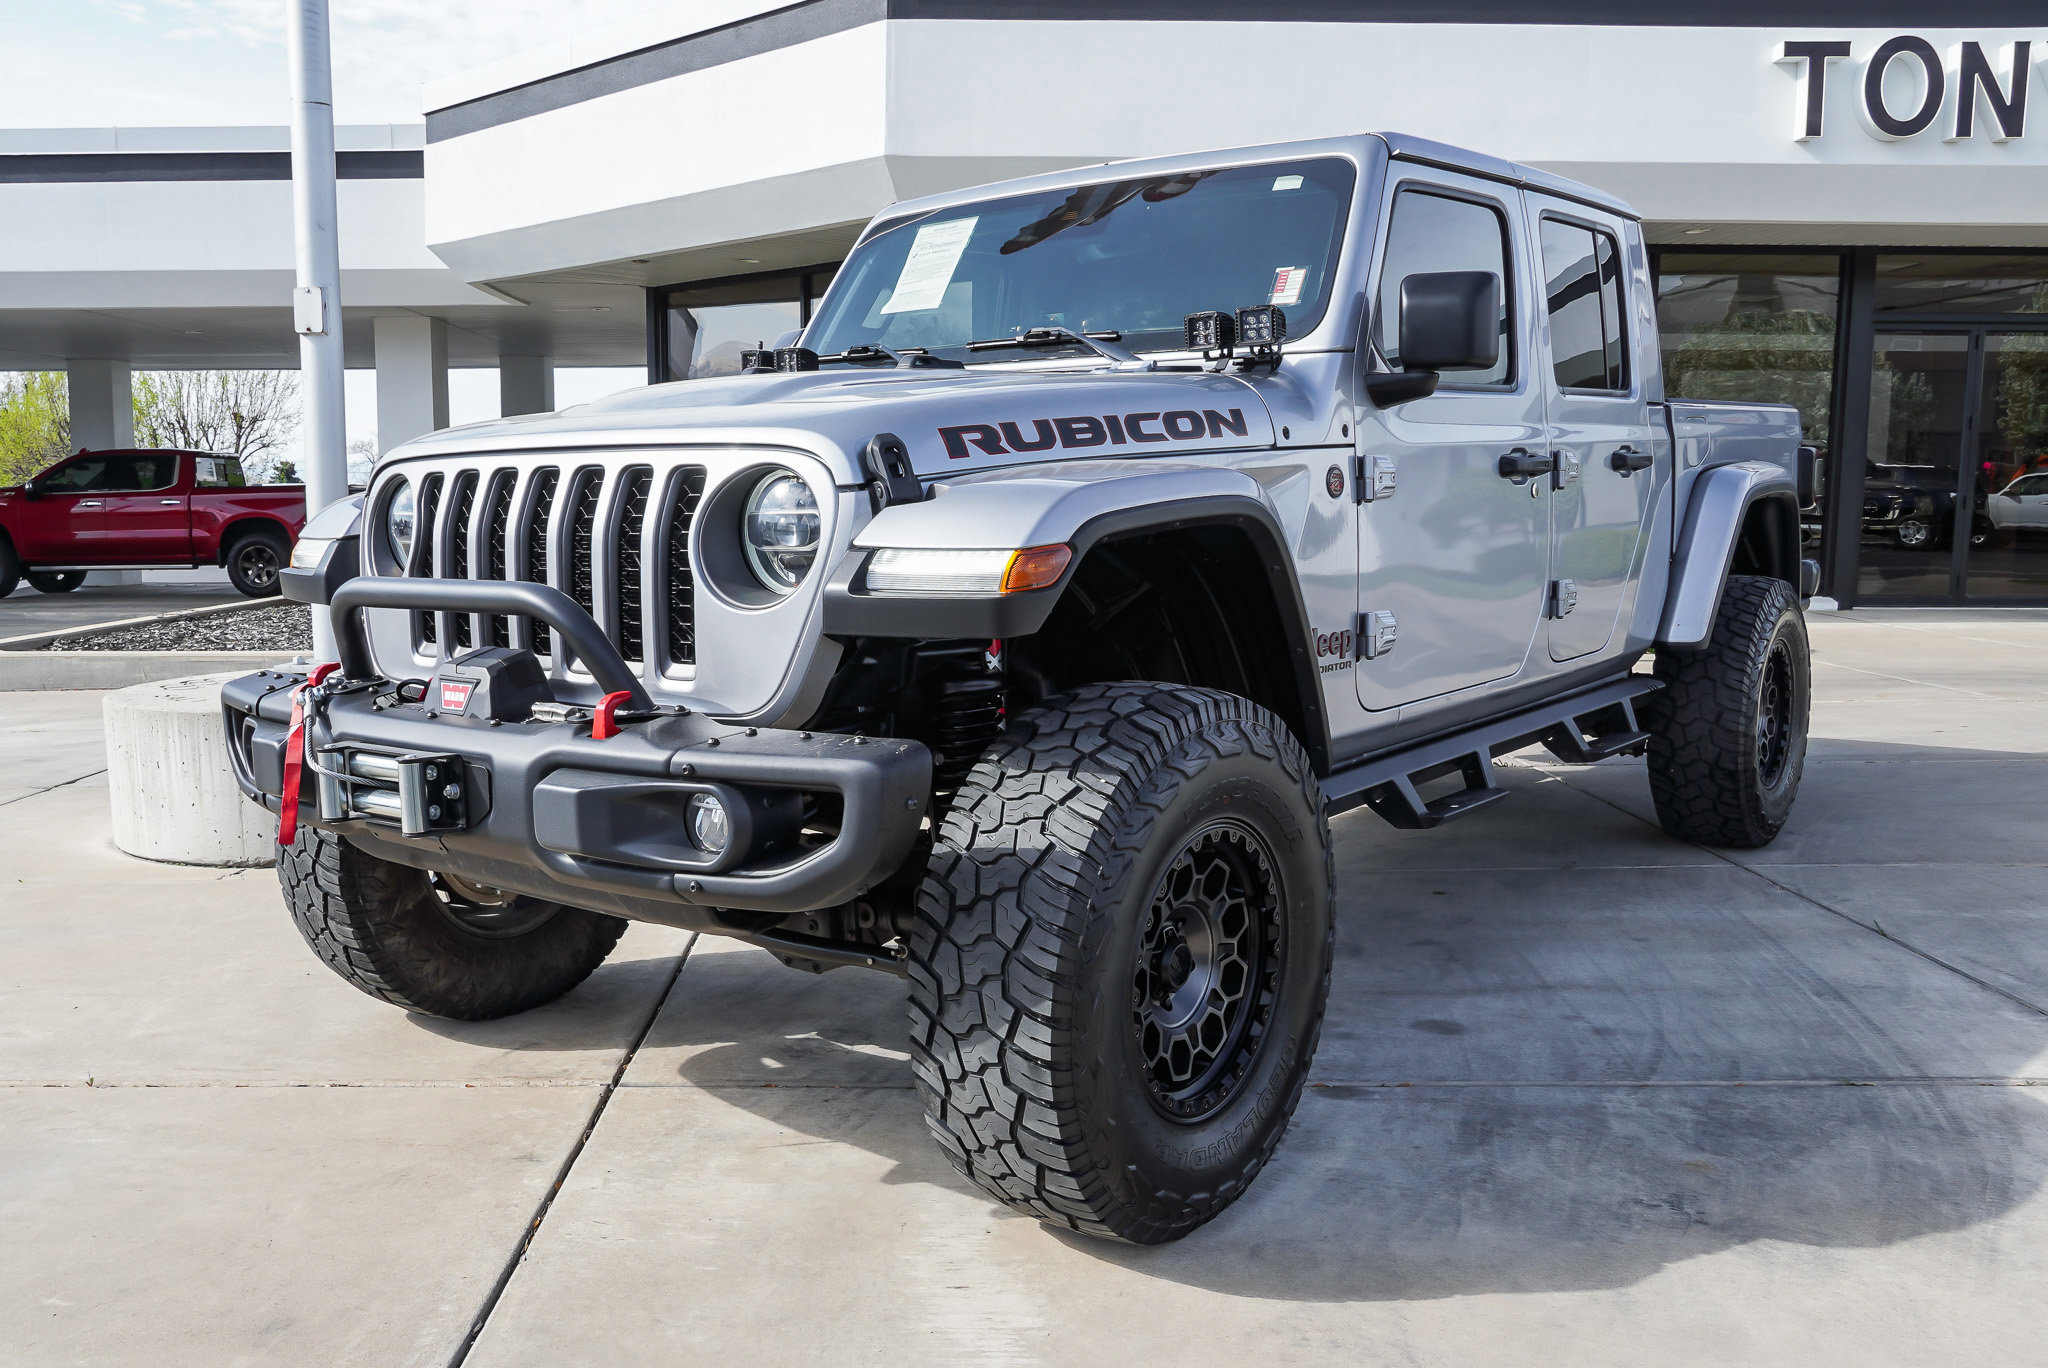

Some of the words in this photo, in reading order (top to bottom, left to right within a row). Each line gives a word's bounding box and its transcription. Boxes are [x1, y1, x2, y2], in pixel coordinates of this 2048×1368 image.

[1784, 35, 2048, 138] TON
[937, 408, 1248, 459] RUBICON
[1320, 660, 1352, 674] DIATOR
[444, 690, 465, 702] WARN
